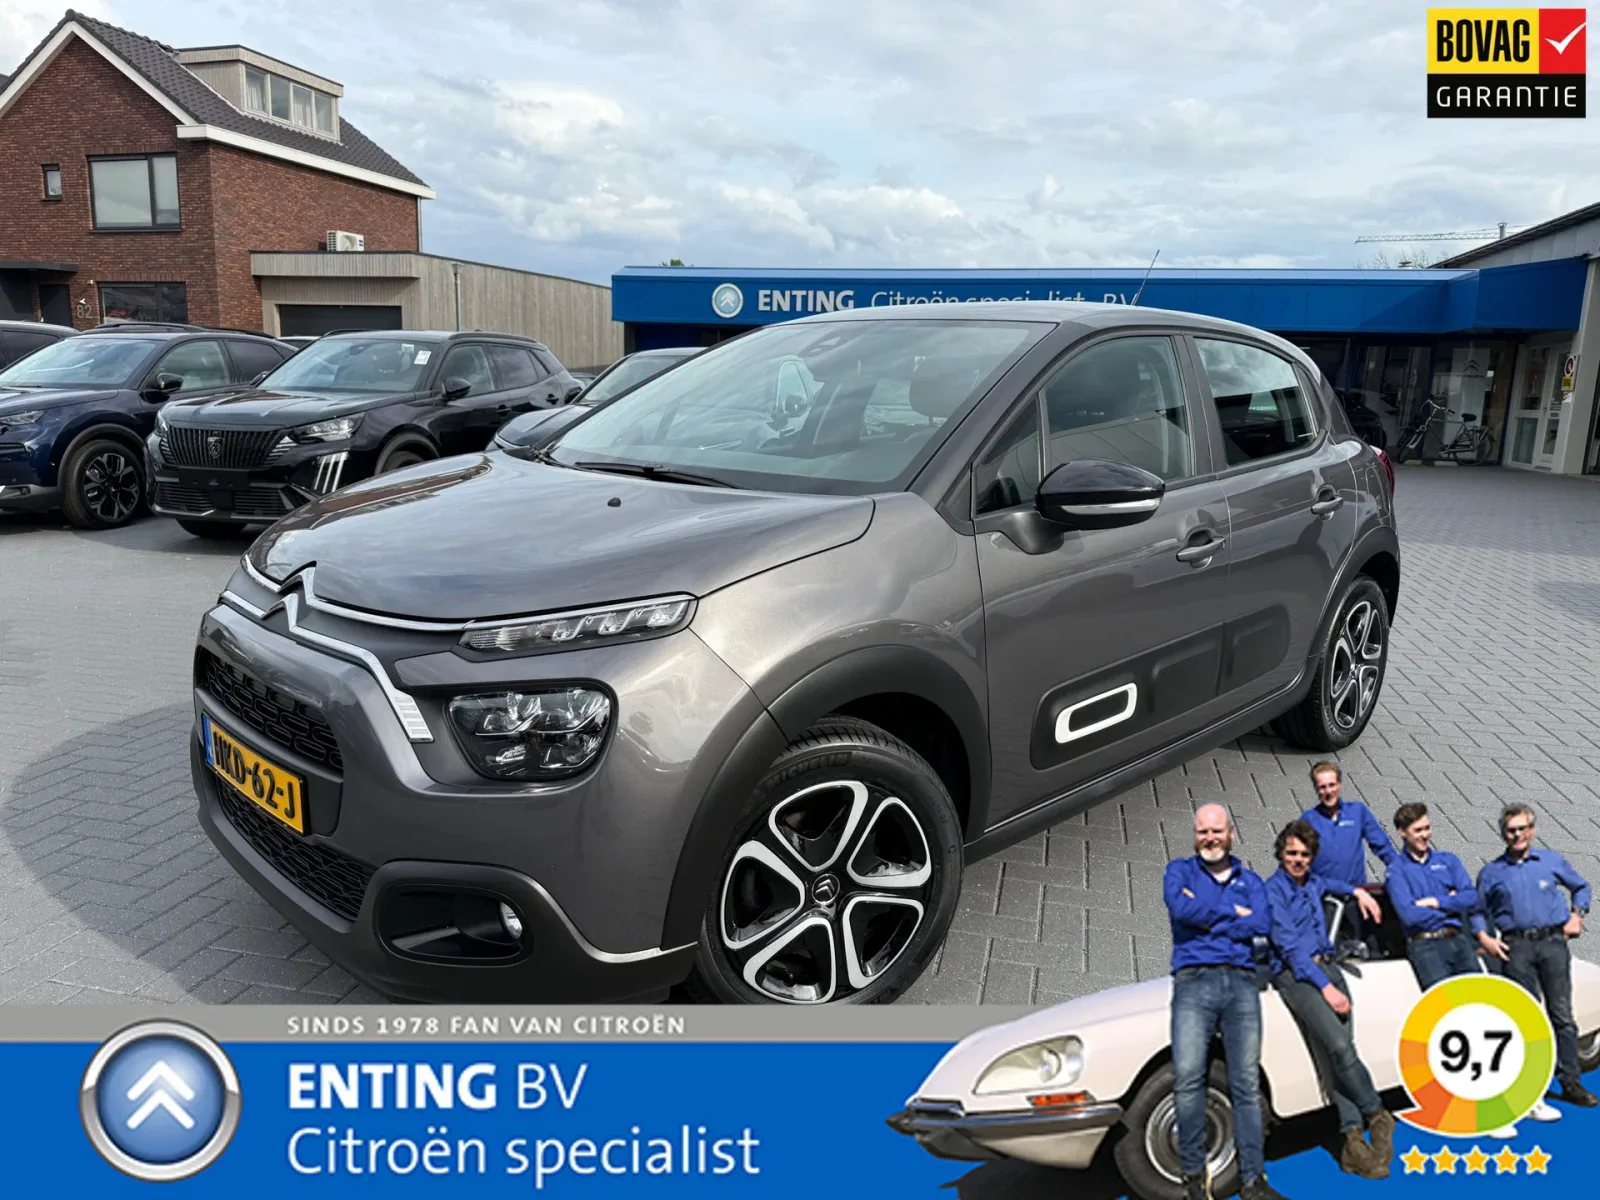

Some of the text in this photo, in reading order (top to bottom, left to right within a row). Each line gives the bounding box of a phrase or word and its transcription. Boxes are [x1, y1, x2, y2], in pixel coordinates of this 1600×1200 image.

[76, 304, 92, 319] 82
[758, 289, 855, 312] ENTING
[212, 731, 295, 819] HKD-62-J
